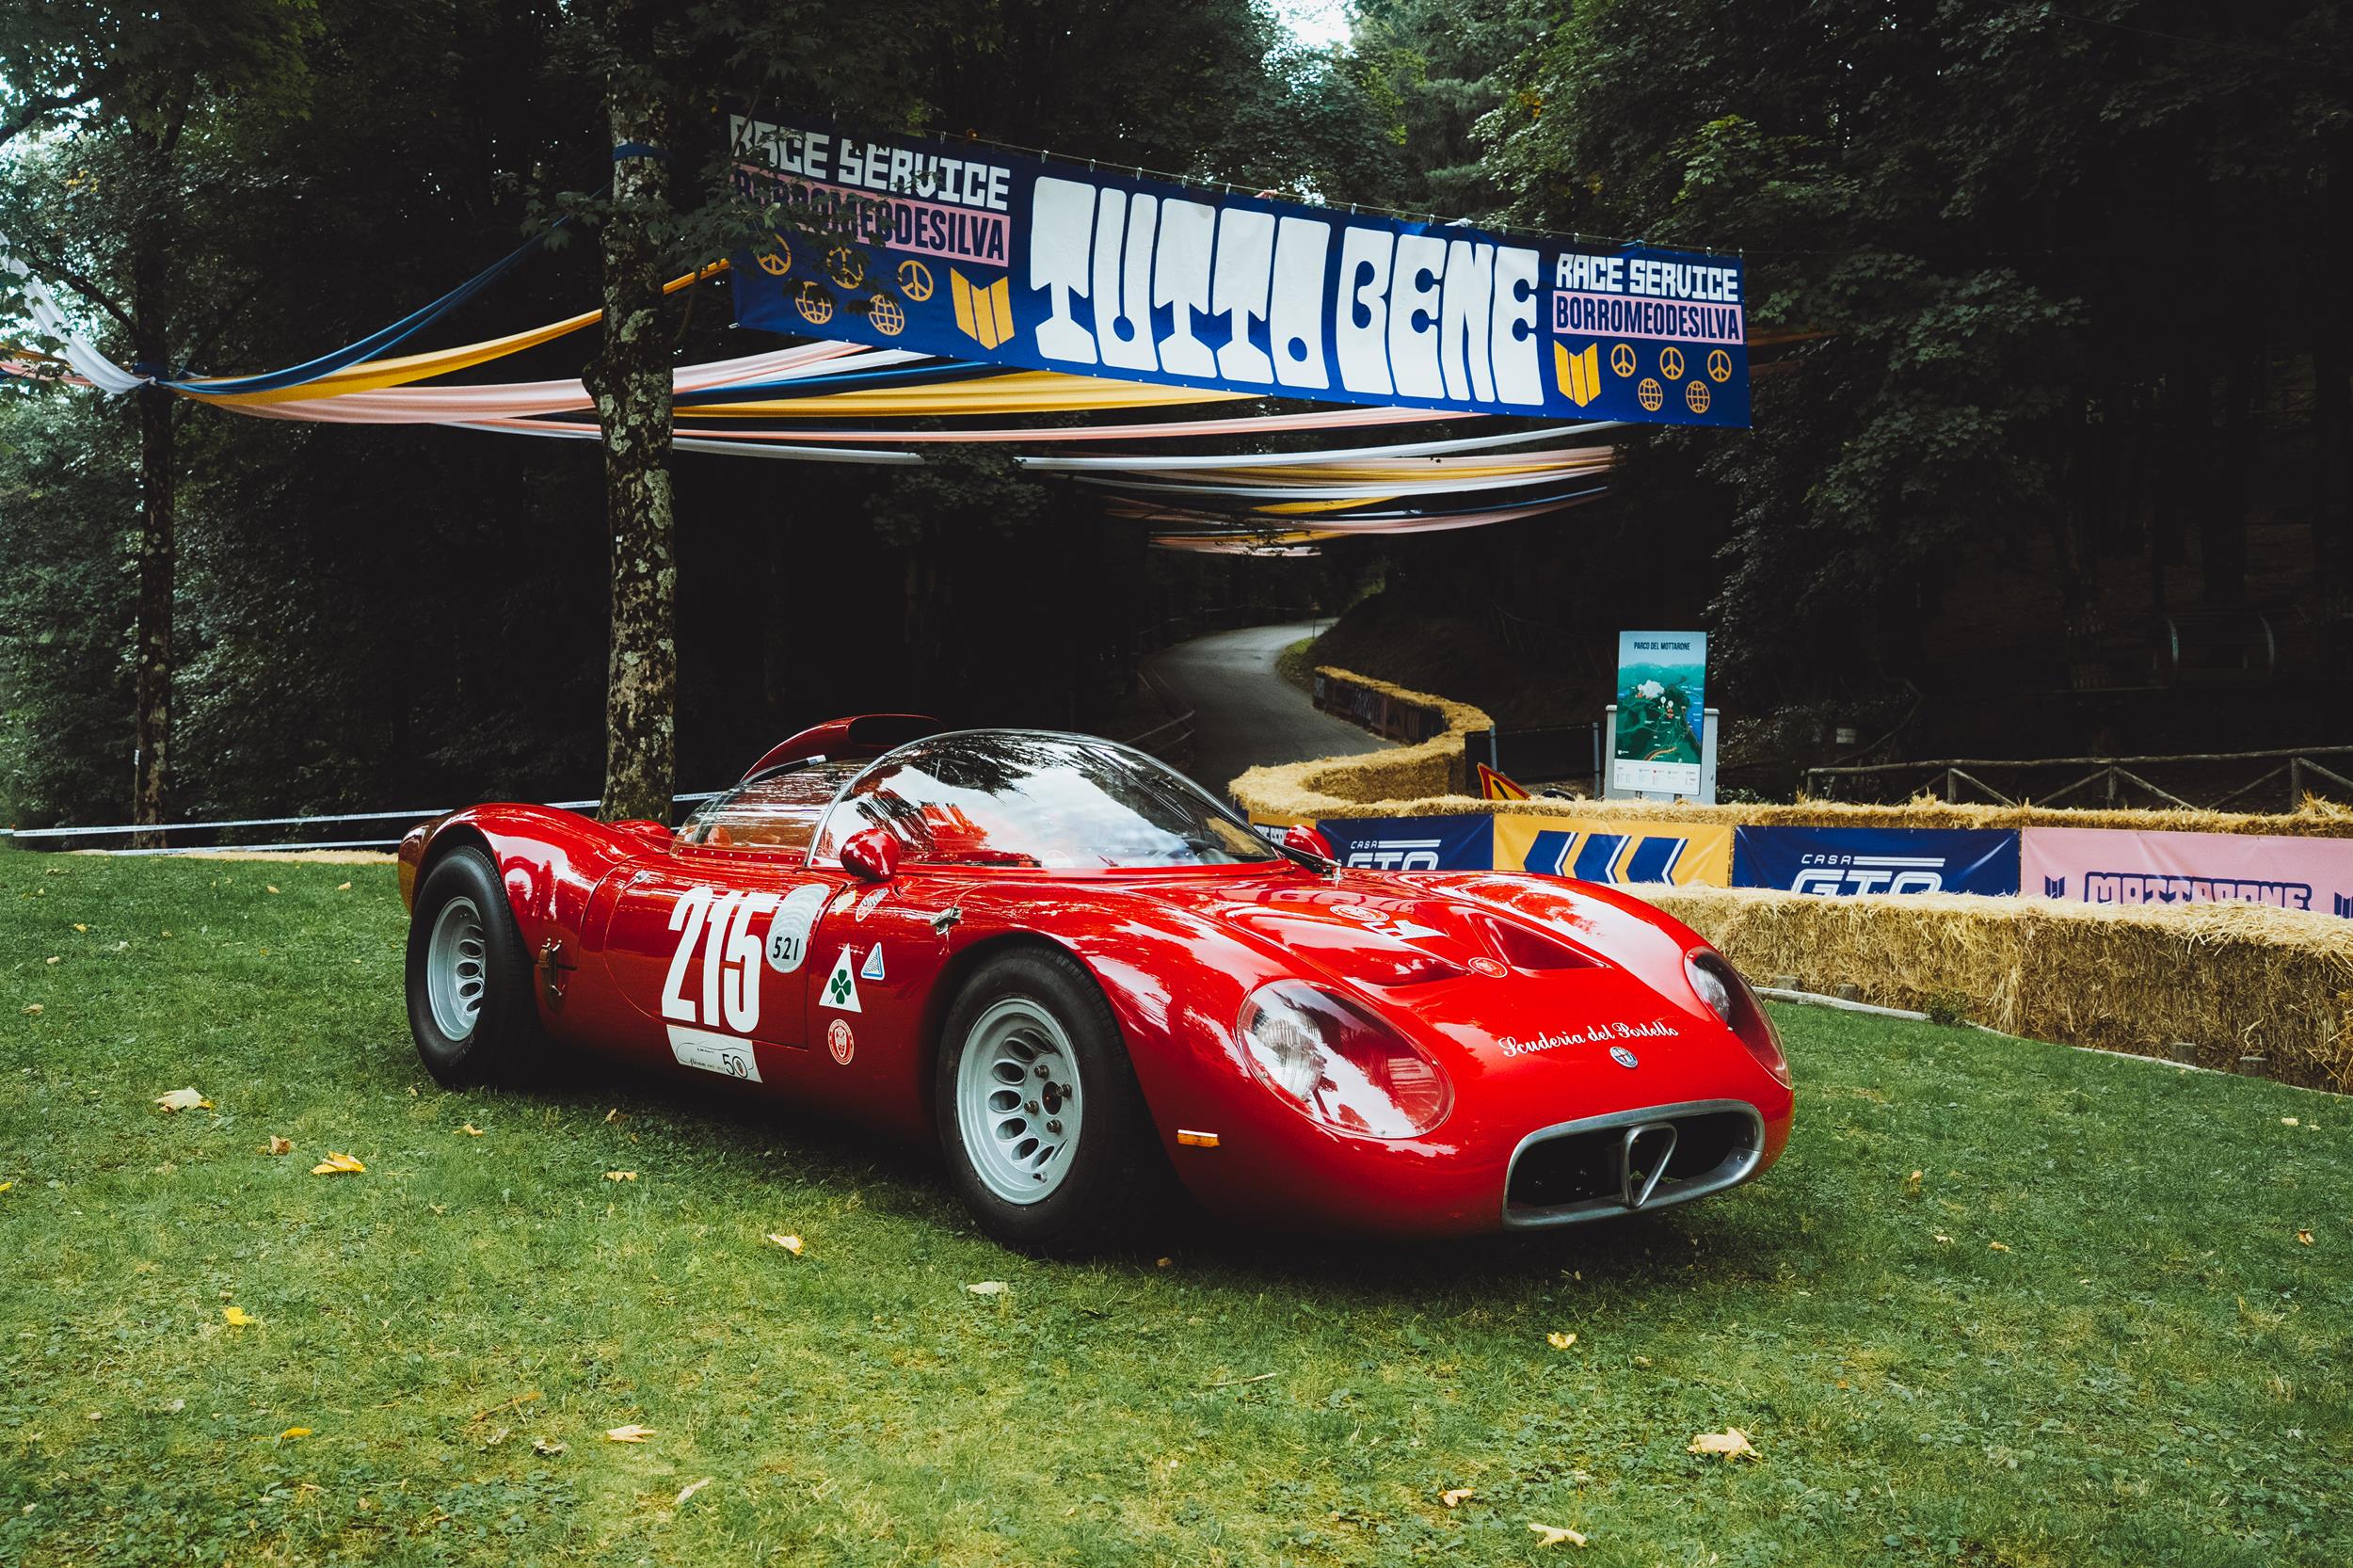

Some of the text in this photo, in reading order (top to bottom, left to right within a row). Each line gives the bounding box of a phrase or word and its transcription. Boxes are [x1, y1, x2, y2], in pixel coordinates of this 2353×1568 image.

[838, 138, 1011, 211] SERVICE
[734, 168, 1005, 261] EODESILVA
[1031, 176, 1545, 406] TUTTO BENE
[1556, 253, 1738, 301] RACE SERVICE
[1556, 296, 1740, 340] BORROMEODESILVA
[1651, 642, 1659, 650] DEL
[1660, 642, 1690, 650] MOTTARONE
[1350, 840, 1378, 849] CASA
[1801, 854, 1851, 865] CASA
[662, 887, 782, 1033] 215
[772, 936, 799, 961] 521
[1498, 1021, 1679, 1057] Scuderia del Portello
[722, 1053, 748, 1079] 50
